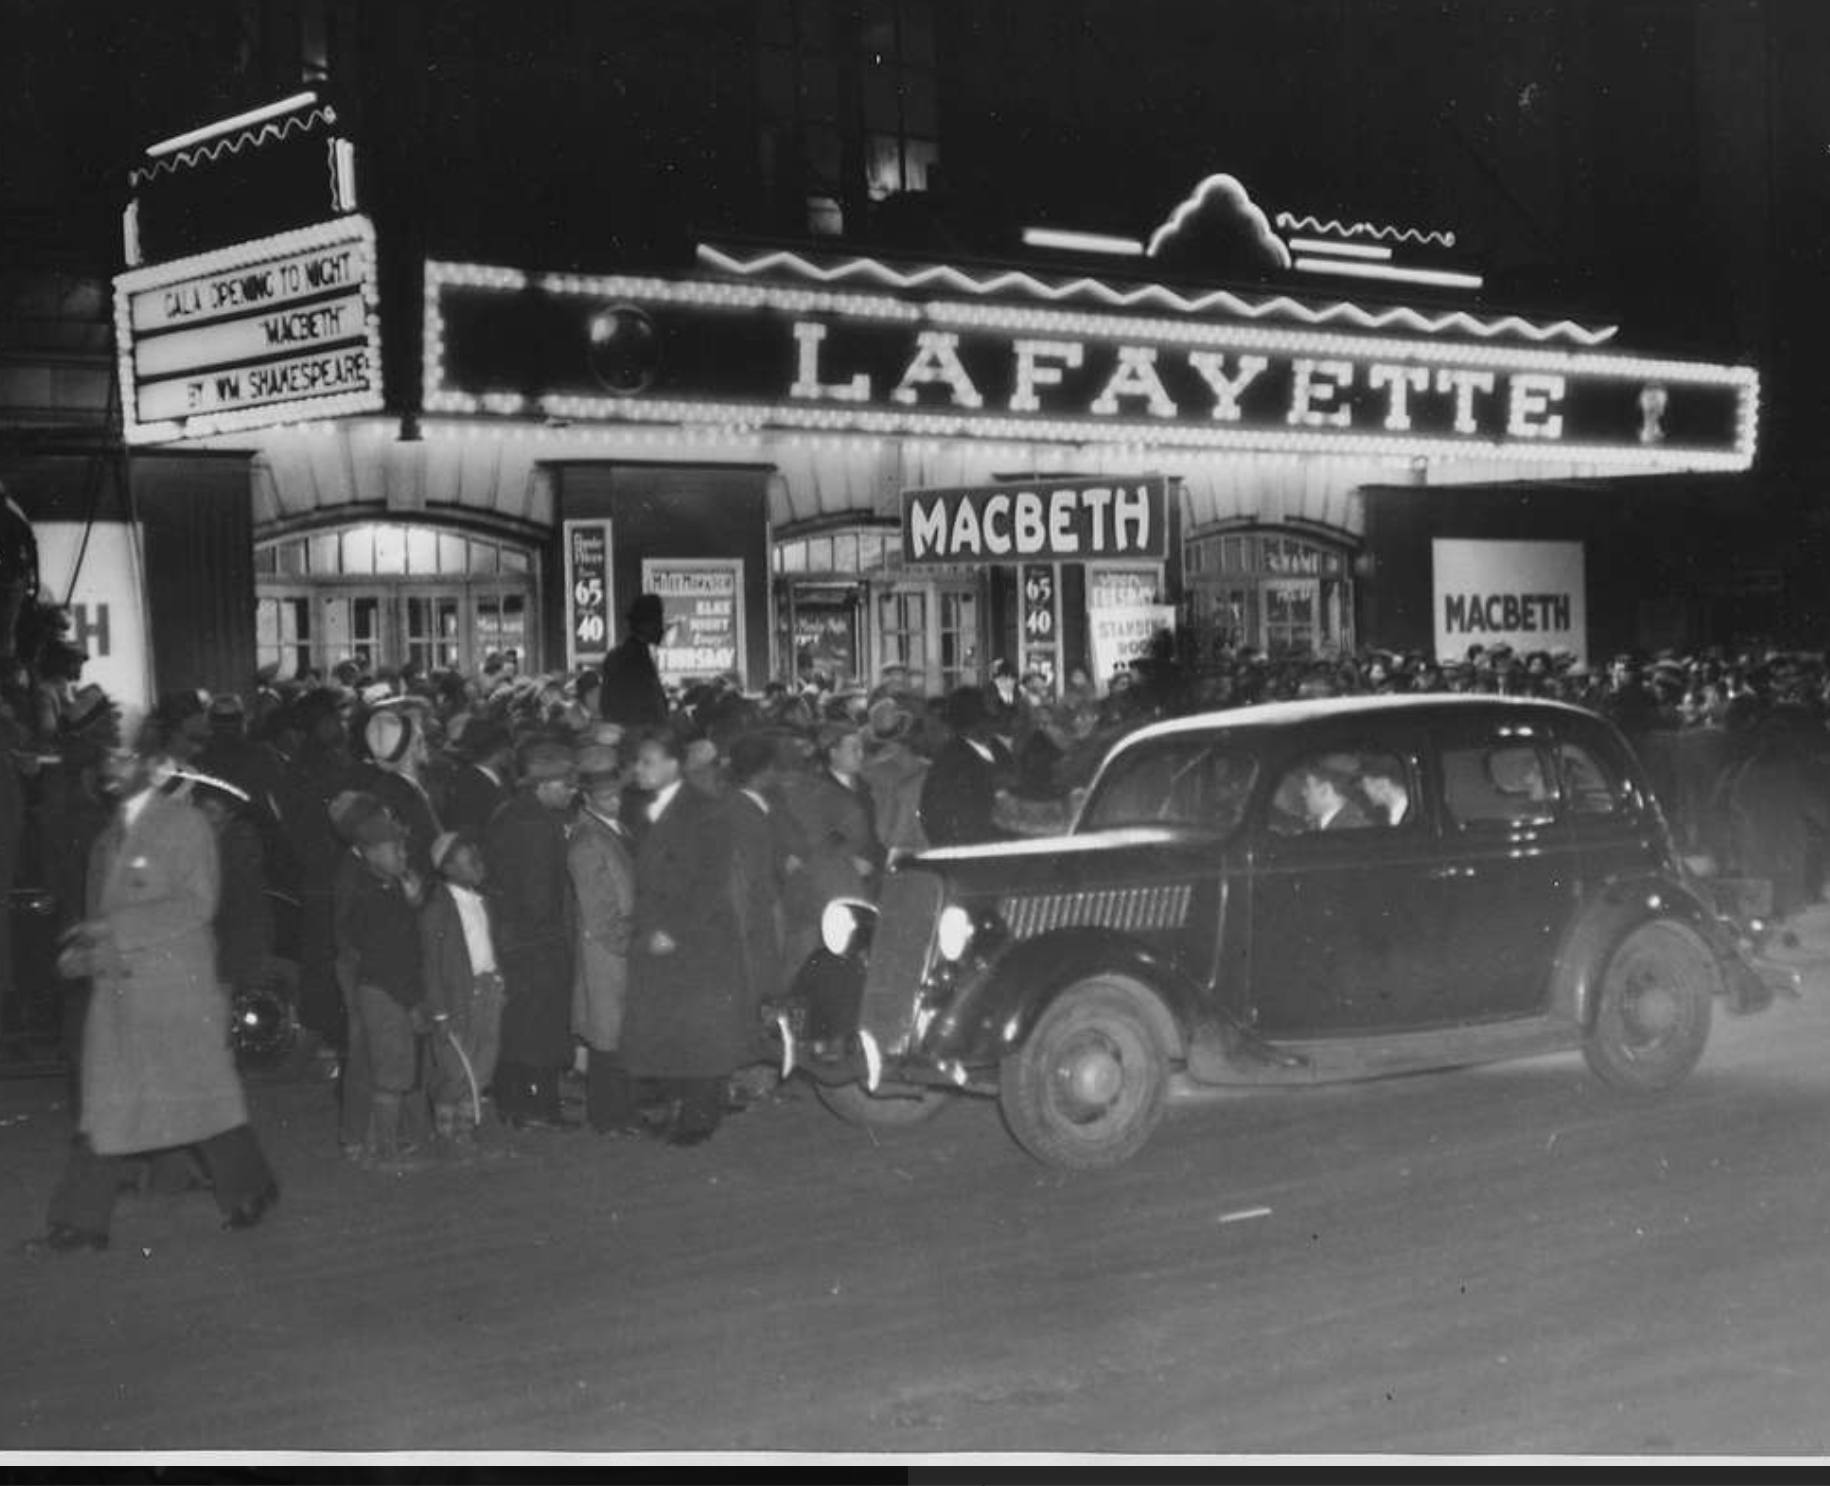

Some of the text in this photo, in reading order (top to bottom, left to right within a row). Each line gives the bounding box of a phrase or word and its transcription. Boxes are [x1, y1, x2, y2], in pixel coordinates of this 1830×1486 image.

[210, 270, 274, 309] OPENING
[280, 263, 299, 296] TO
[304, 251, 350, 288] NIGHT
[790, 321, 1566, 439] LAFAYETTE
[910, 486, 1150, 559] MACBETH
[575, 578, 603, 606] 65
[1026, 577, 1052, 601] 65
[577, 615, 604, 642] 40
[1026, 610, 1052, 635] 40
[1445, 593, 1571, 634] MACBETH
